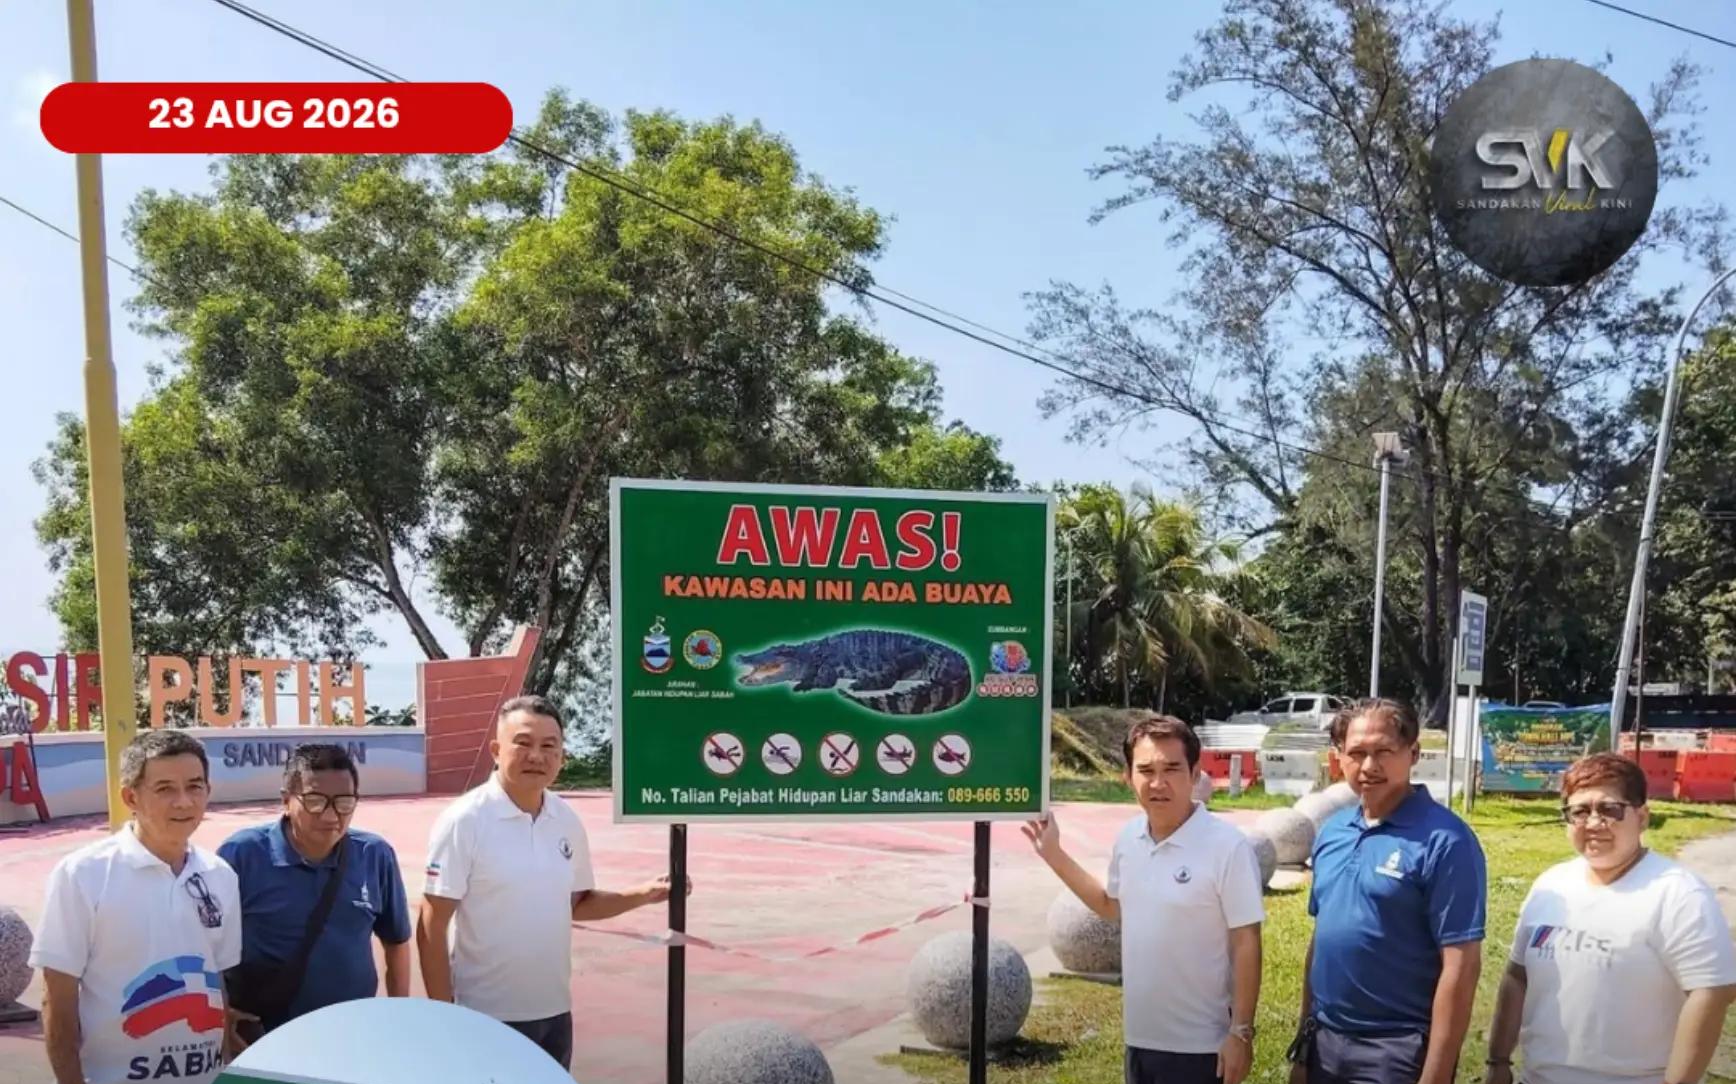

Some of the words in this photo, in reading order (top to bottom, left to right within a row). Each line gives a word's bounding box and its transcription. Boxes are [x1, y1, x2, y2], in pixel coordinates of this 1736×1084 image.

[716, 504, 963, 572] AWAS!
[664, 574, 806, 600] KAWASAN
[816, 579, 853, 602] INI
[862, 580, 917, 603] ADA
[925, 581, 1012, 604] BUAYA
[148, 655, 367, 728] PUTIH
[223, 741, 367, 768] SANDN
[642, 788, 667, 804] No.
[670, 787, 715, 804] Talian
[719, 787, 774, 806] Pejabat
[778, 787, 836, 806] Hidupan
[840, 788, 868, 804] Liar
[871, 787, 943, 804] Sandakan:
[947, 787, 1001, 803] 089-666
[1004, 787, 1030, 803] 550
